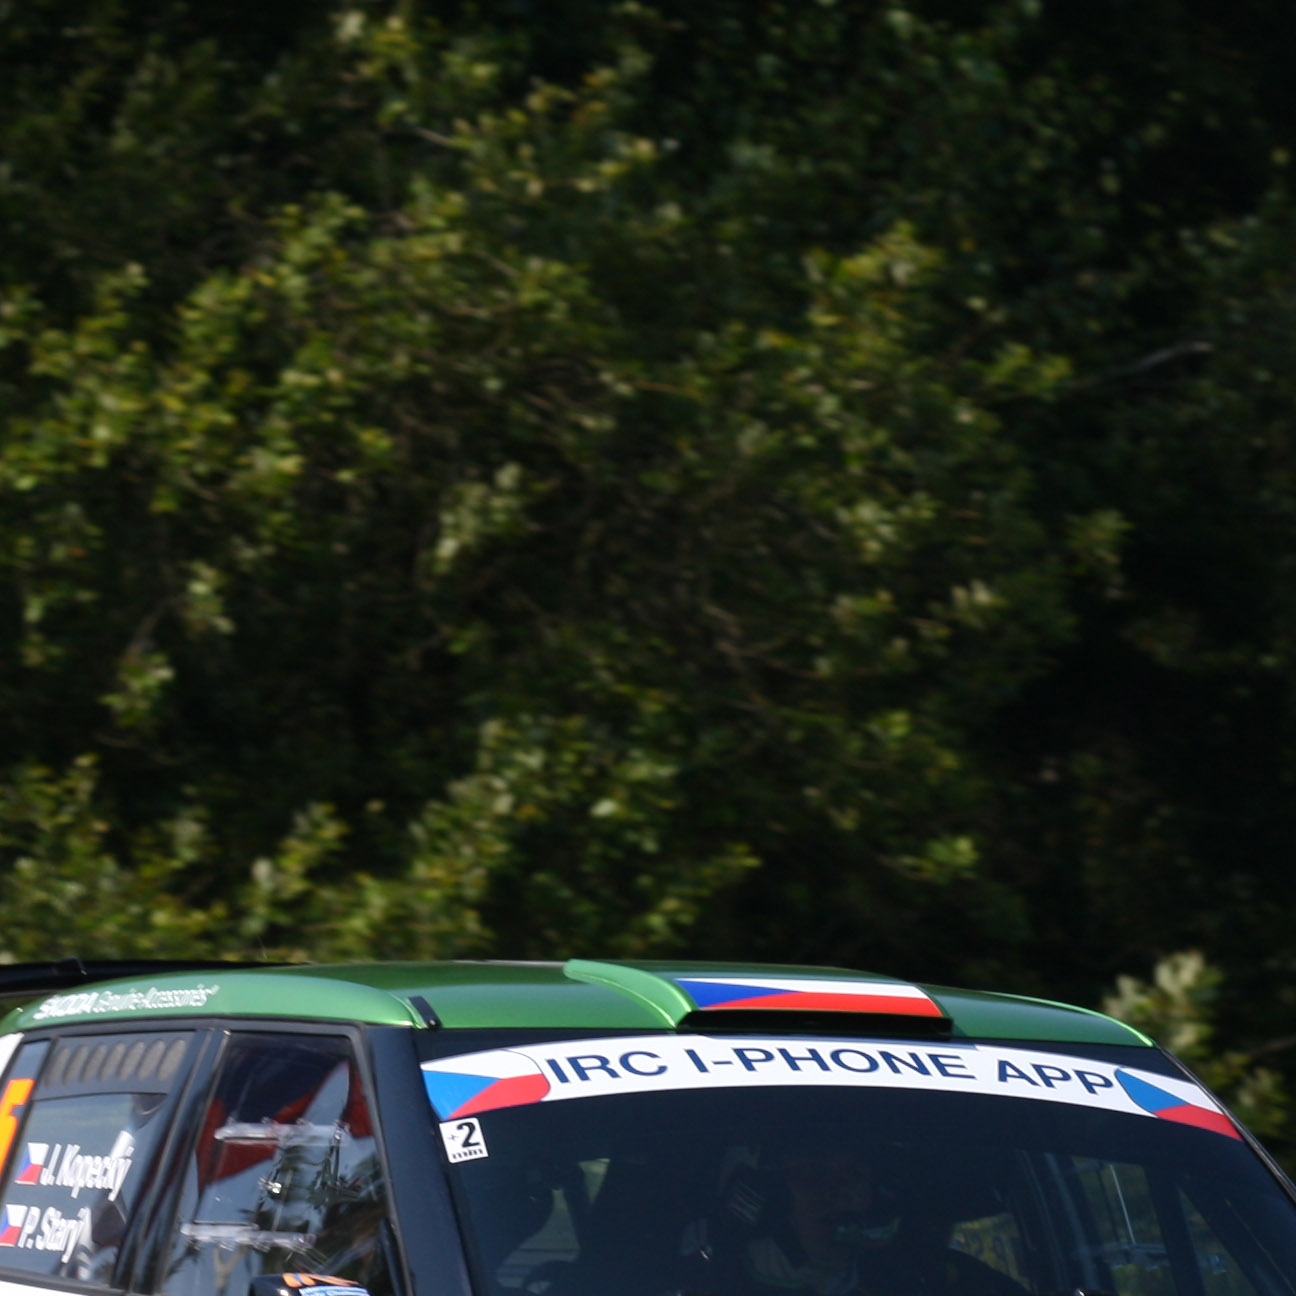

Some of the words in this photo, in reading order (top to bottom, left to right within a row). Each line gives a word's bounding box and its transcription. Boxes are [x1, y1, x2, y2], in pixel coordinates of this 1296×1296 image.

[547, 1050, 668, 1084] IRC
[684, 1047, 977, 1080] I-PHONE
[996, 1060, 1115, 1096] APP
[40, 1143, 62, 1186] J.
[18, 1205, 42, 1249] P.
